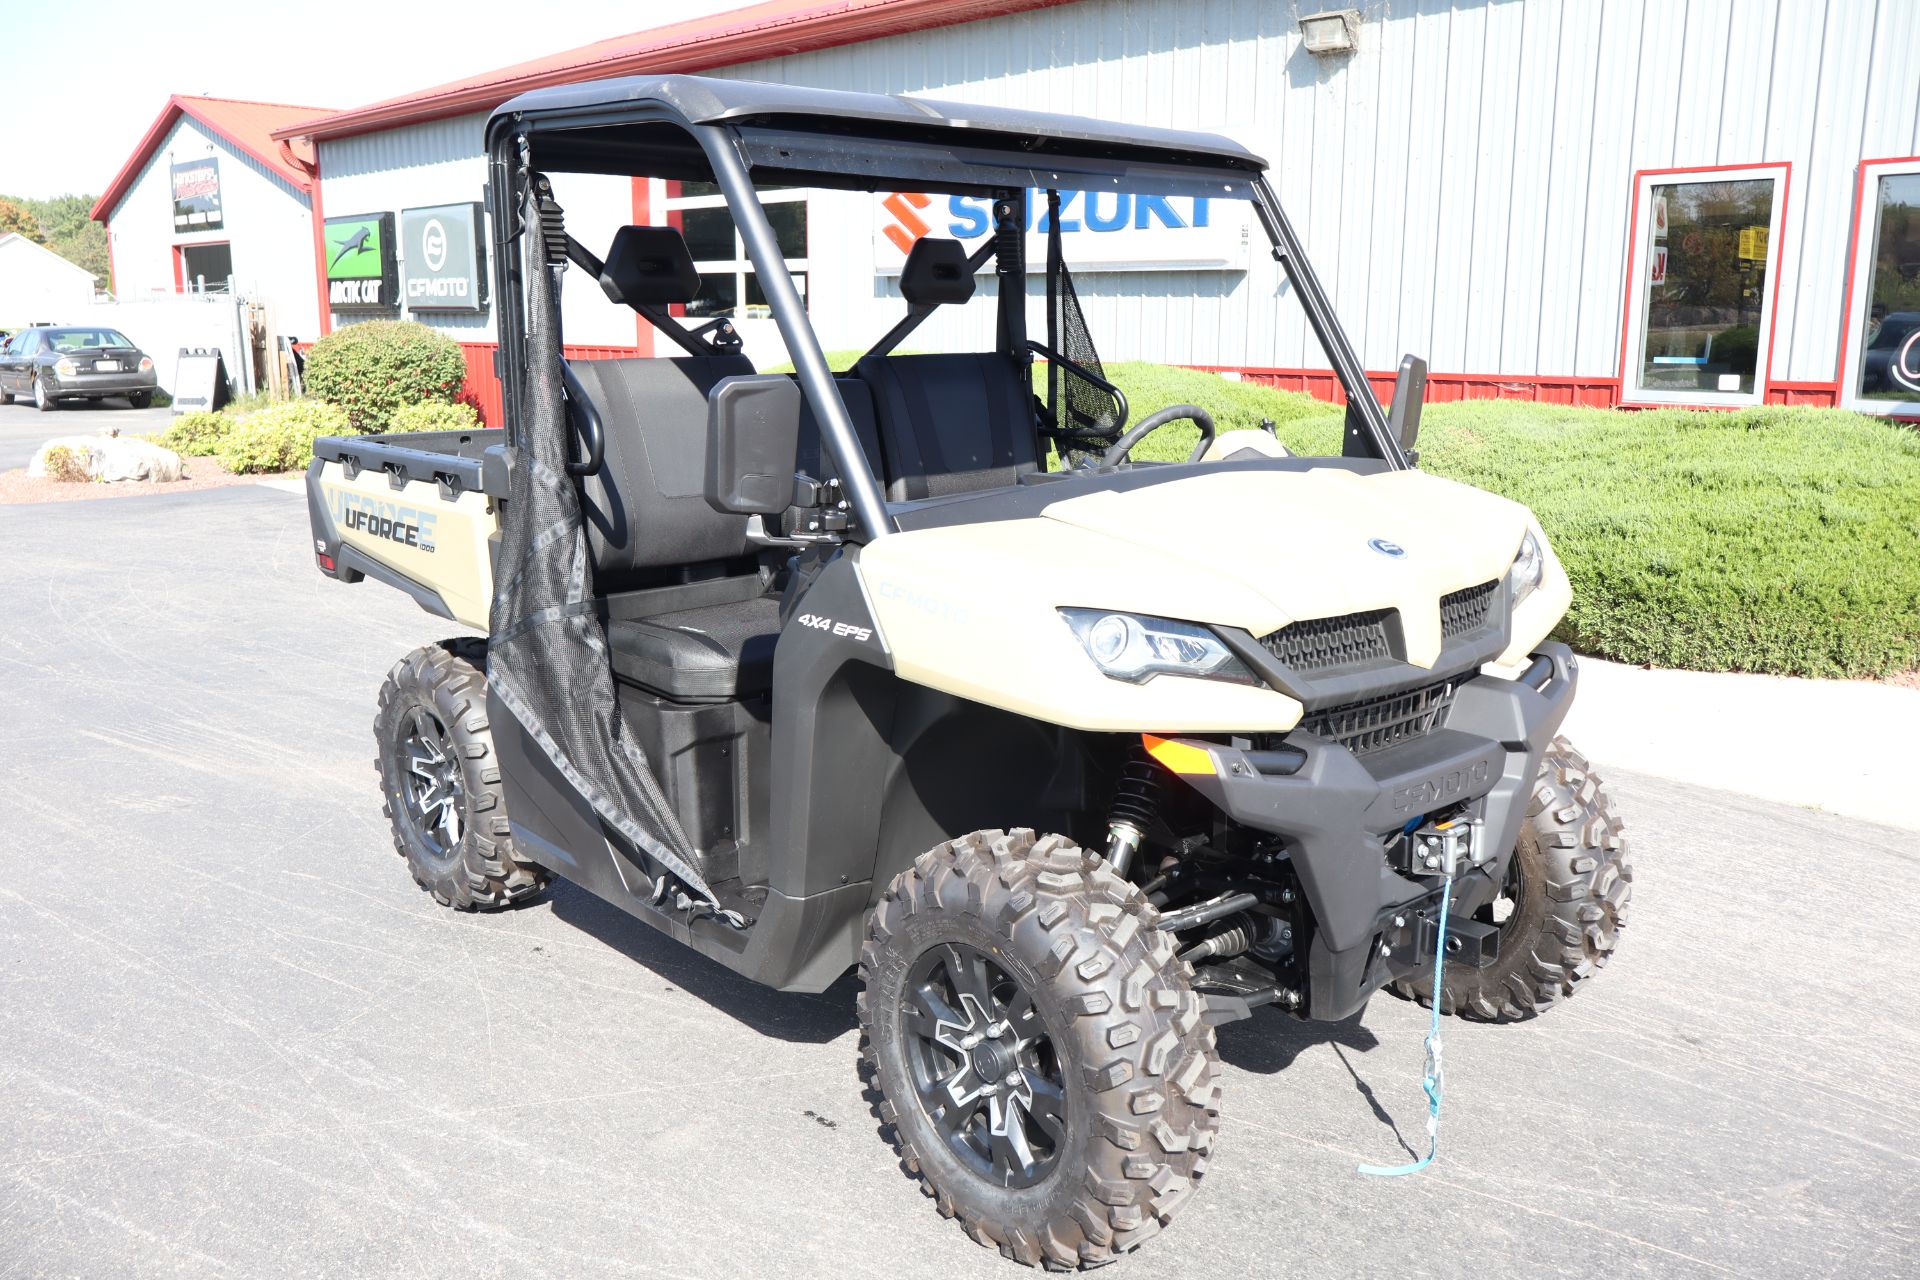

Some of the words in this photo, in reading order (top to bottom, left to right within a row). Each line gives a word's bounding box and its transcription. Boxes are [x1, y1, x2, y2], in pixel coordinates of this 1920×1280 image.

[330, 280, 360, 304] ARCTIC
[361, 279, 382, 303] CAT
[407, 278, 469, 298] CFMOTO
[345, 507, 419, 548] UFORCE
[419, 543, 435, 553] 1000
[832, 622, 873, 641] EPS
[1394, 760, 1489, 812] CFMOTO
